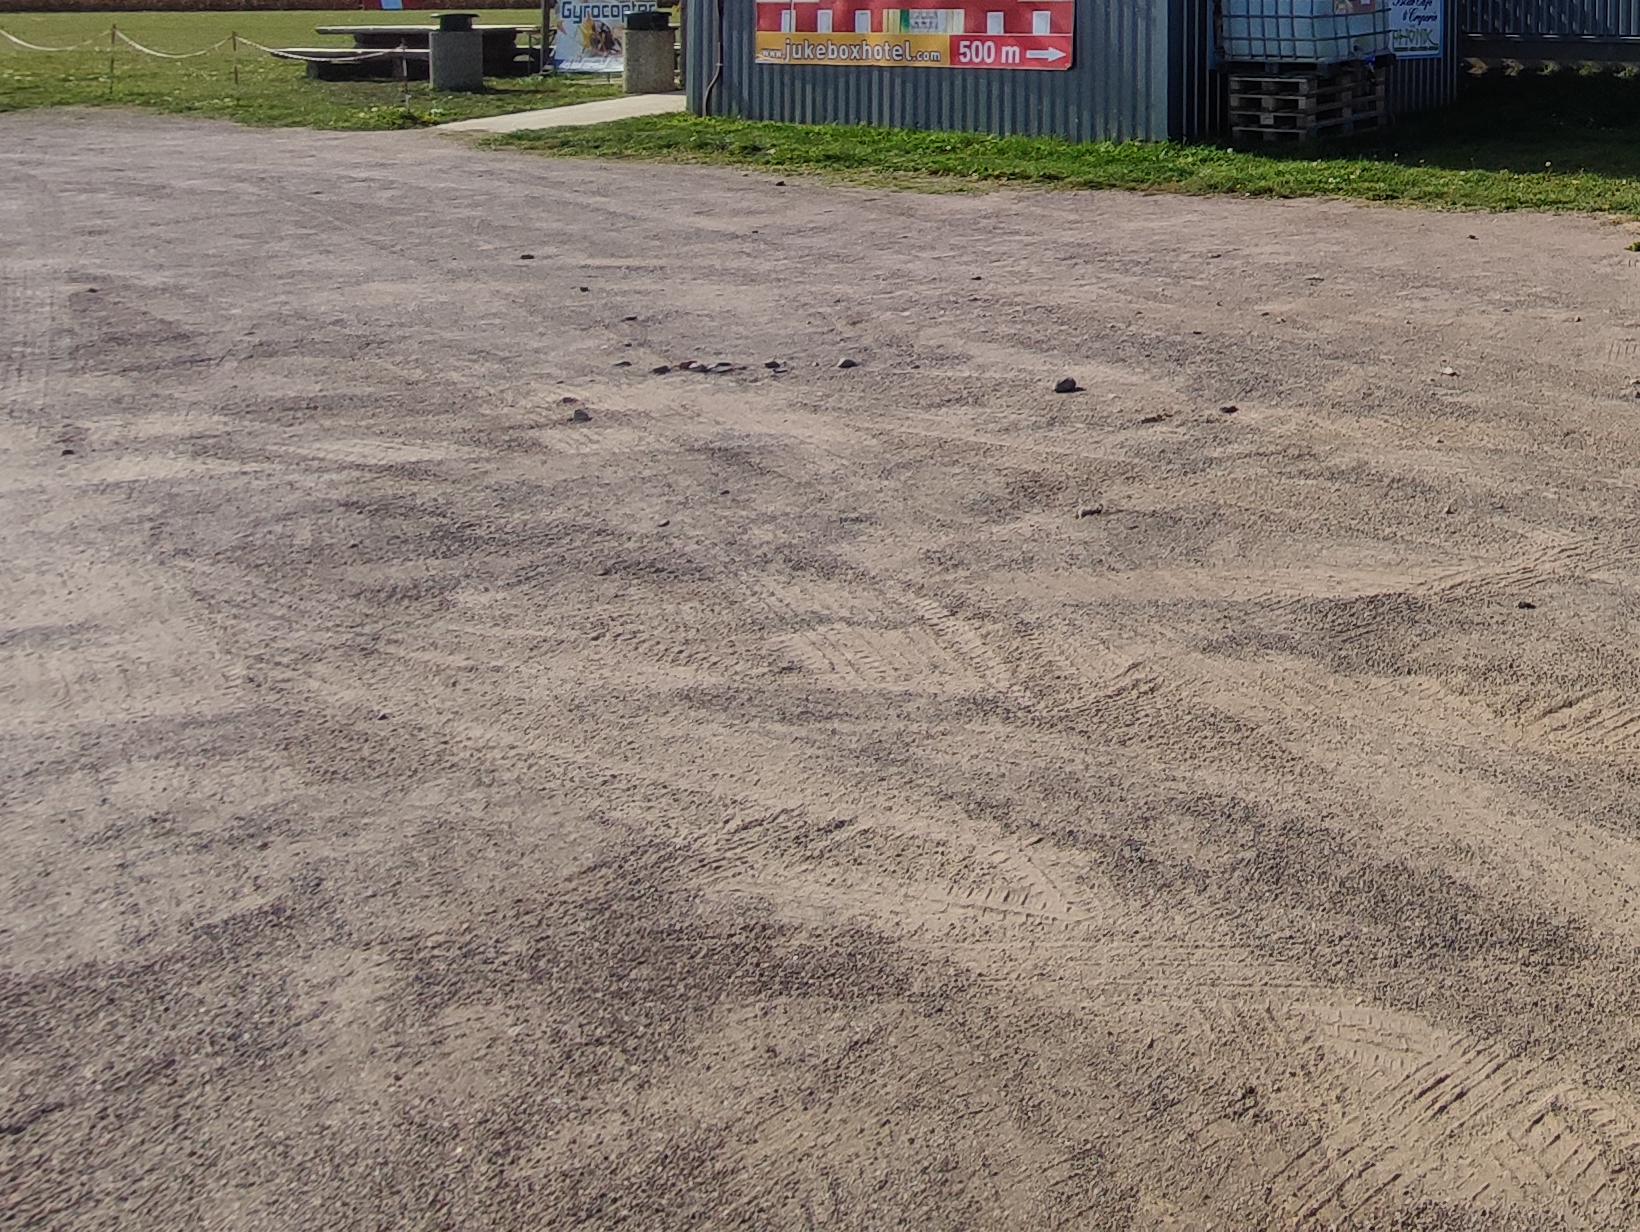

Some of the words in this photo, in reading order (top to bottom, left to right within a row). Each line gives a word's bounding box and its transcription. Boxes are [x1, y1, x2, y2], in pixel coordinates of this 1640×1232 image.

[761, 38, 942, 62] www.jukeboxhotel.com
[959, 40, 996, 63] 500
[1001, 45, 1020, 64] m
